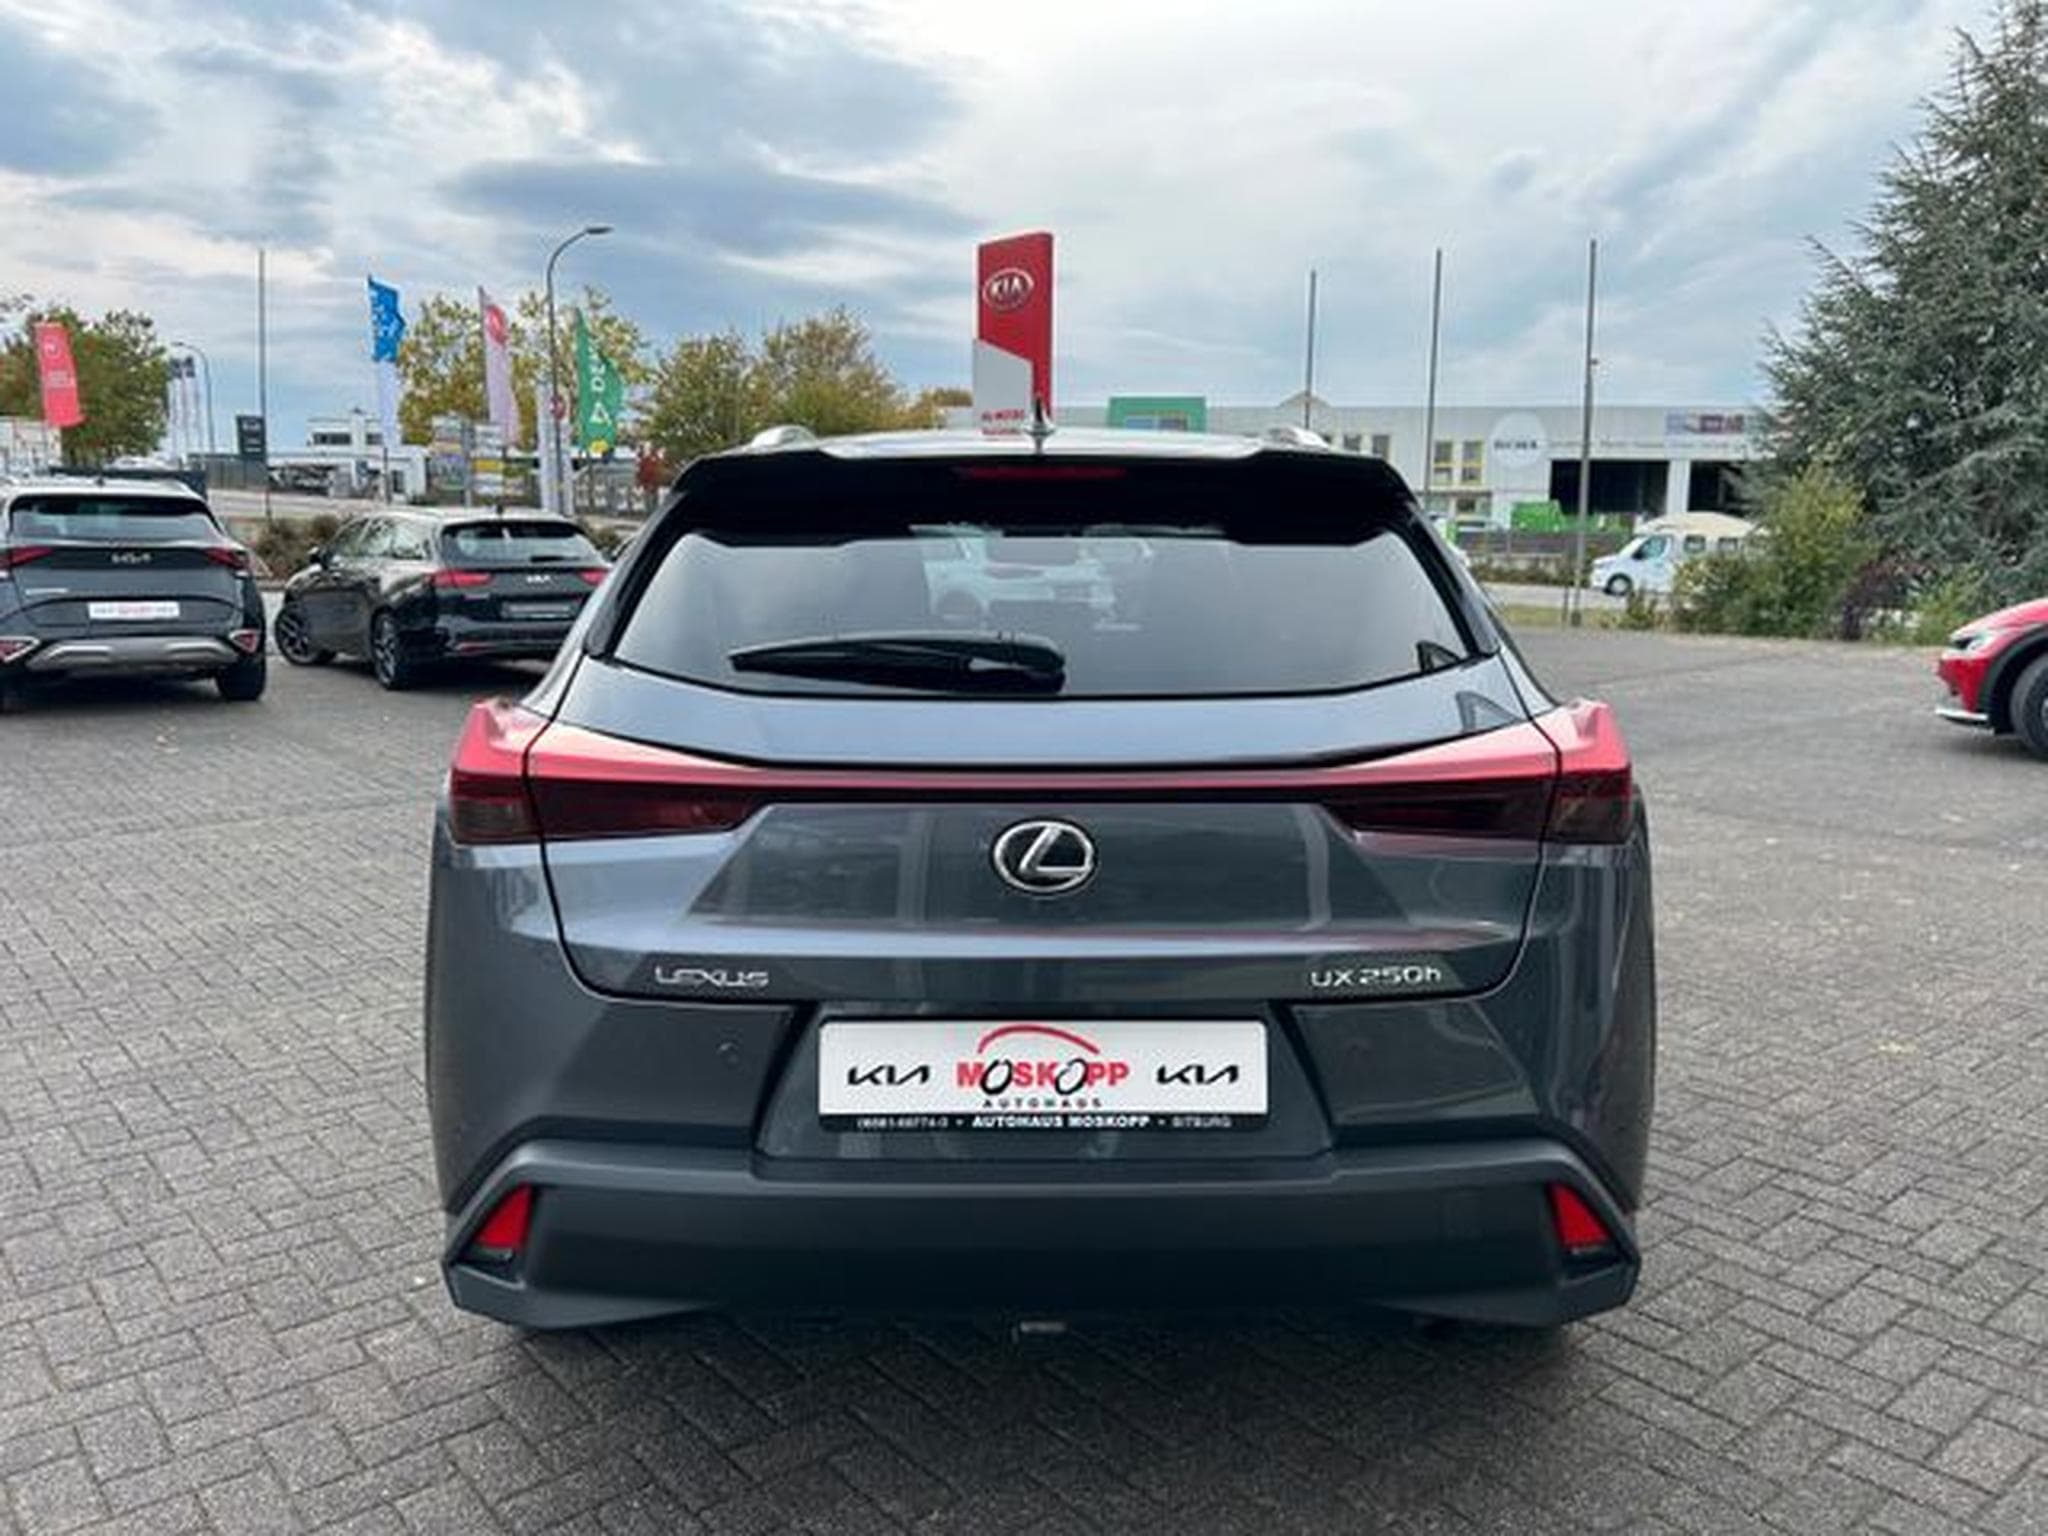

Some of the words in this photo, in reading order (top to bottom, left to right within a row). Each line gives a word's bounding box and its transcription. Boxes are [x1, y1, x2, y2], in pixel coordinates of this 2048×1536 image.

[990, 276, 1023, 299] KIA
[655, 965, 769, 988] LEXUS
[1310, 968, 1354, 987] UX
[1359, 965, 1442, 985] 250h
[847, 1064, 930, 1086] KIA
[956, 1059, 1129, 1095] MOSKOPP
[1156, 1064, 1239, 1085] KIA
[982, 1098, 1102, 1108] AUTOHAUS
[972, 1115, 1064, 1128] AUTOHAUS
[1067, 1115, 1150, 1128] MOSKOPP
